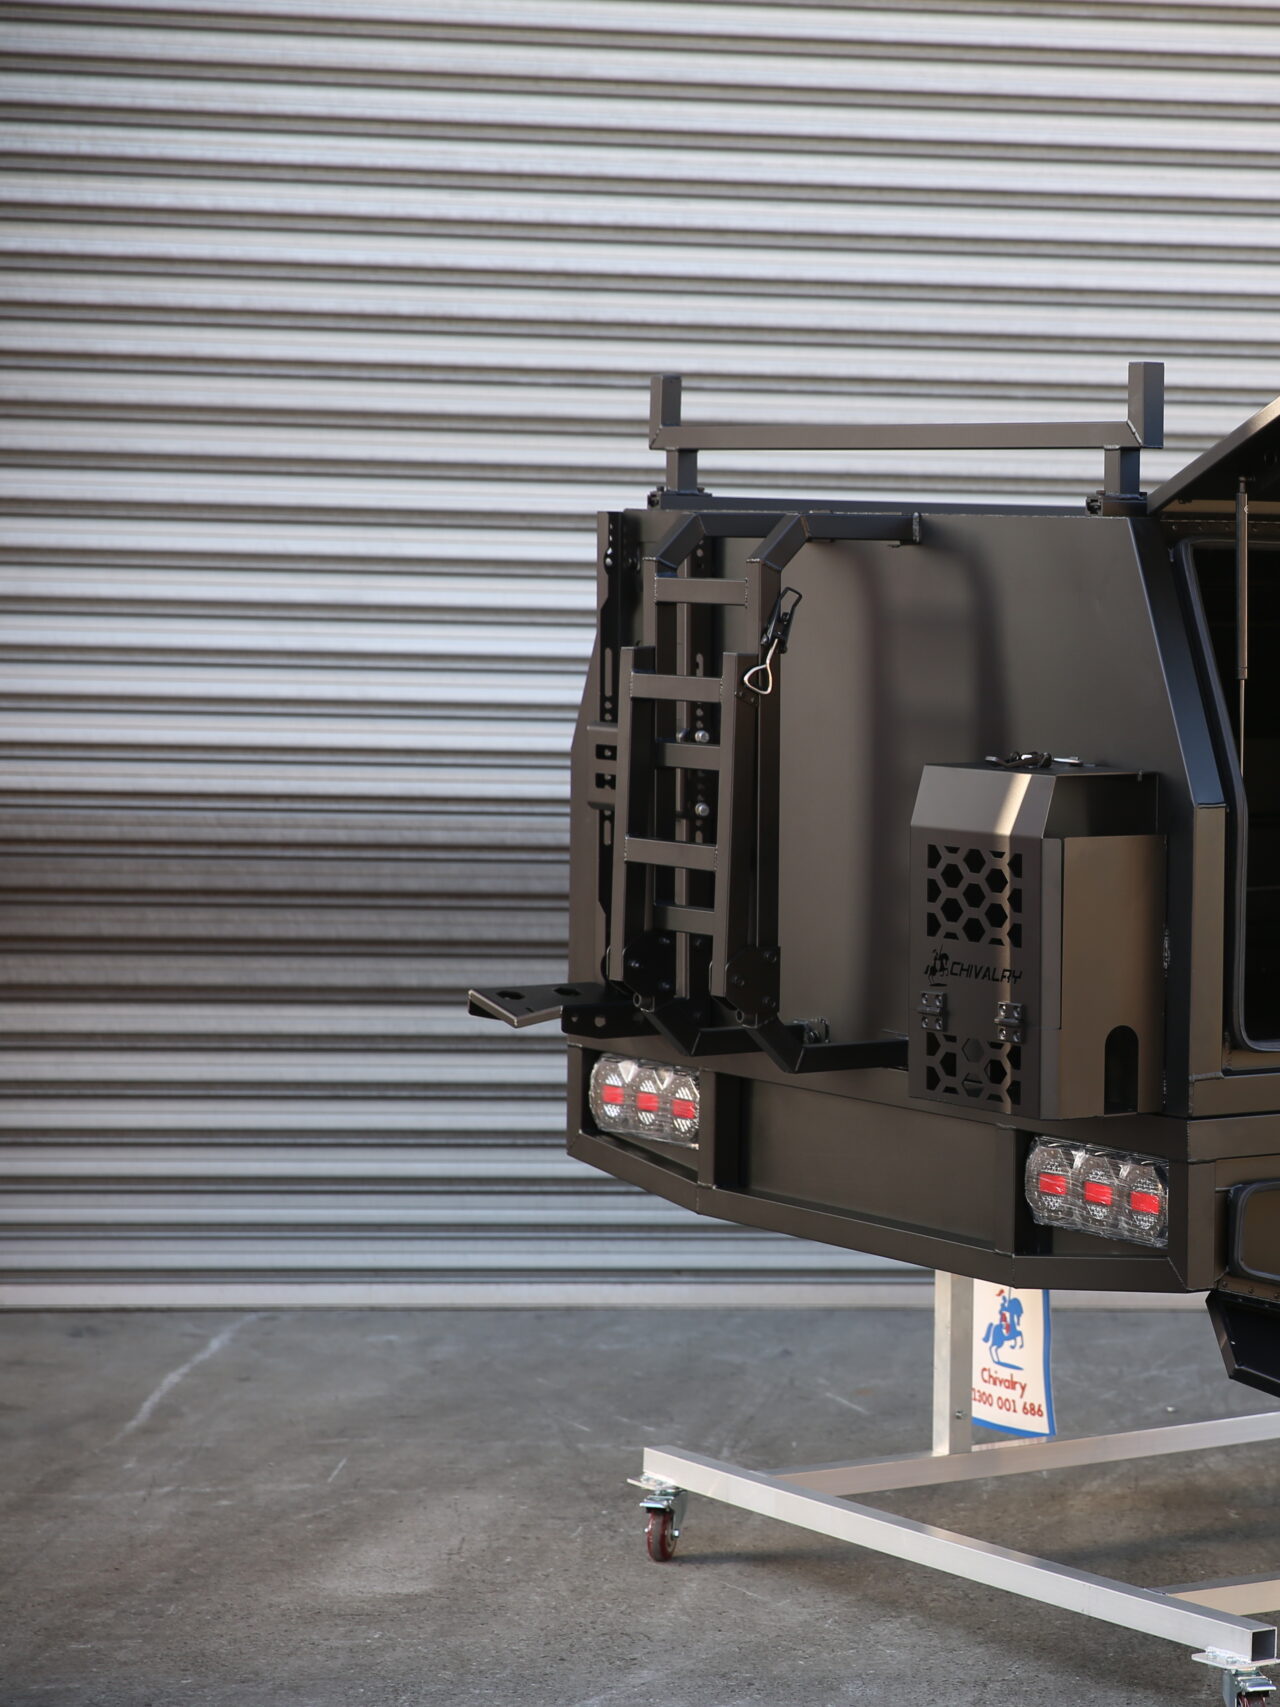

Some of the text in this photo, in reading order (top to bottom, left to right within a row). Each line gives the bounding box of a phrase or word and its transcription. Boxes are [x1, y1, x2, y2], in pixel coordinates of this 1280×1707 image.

[950, 961, 1023, 984] CHIVALRY
[980, 1367, 1027, 1399] Chivalry
[997, 1395, 1018, 1413] 001
[1022, 1401, 1044, 1417] 686
